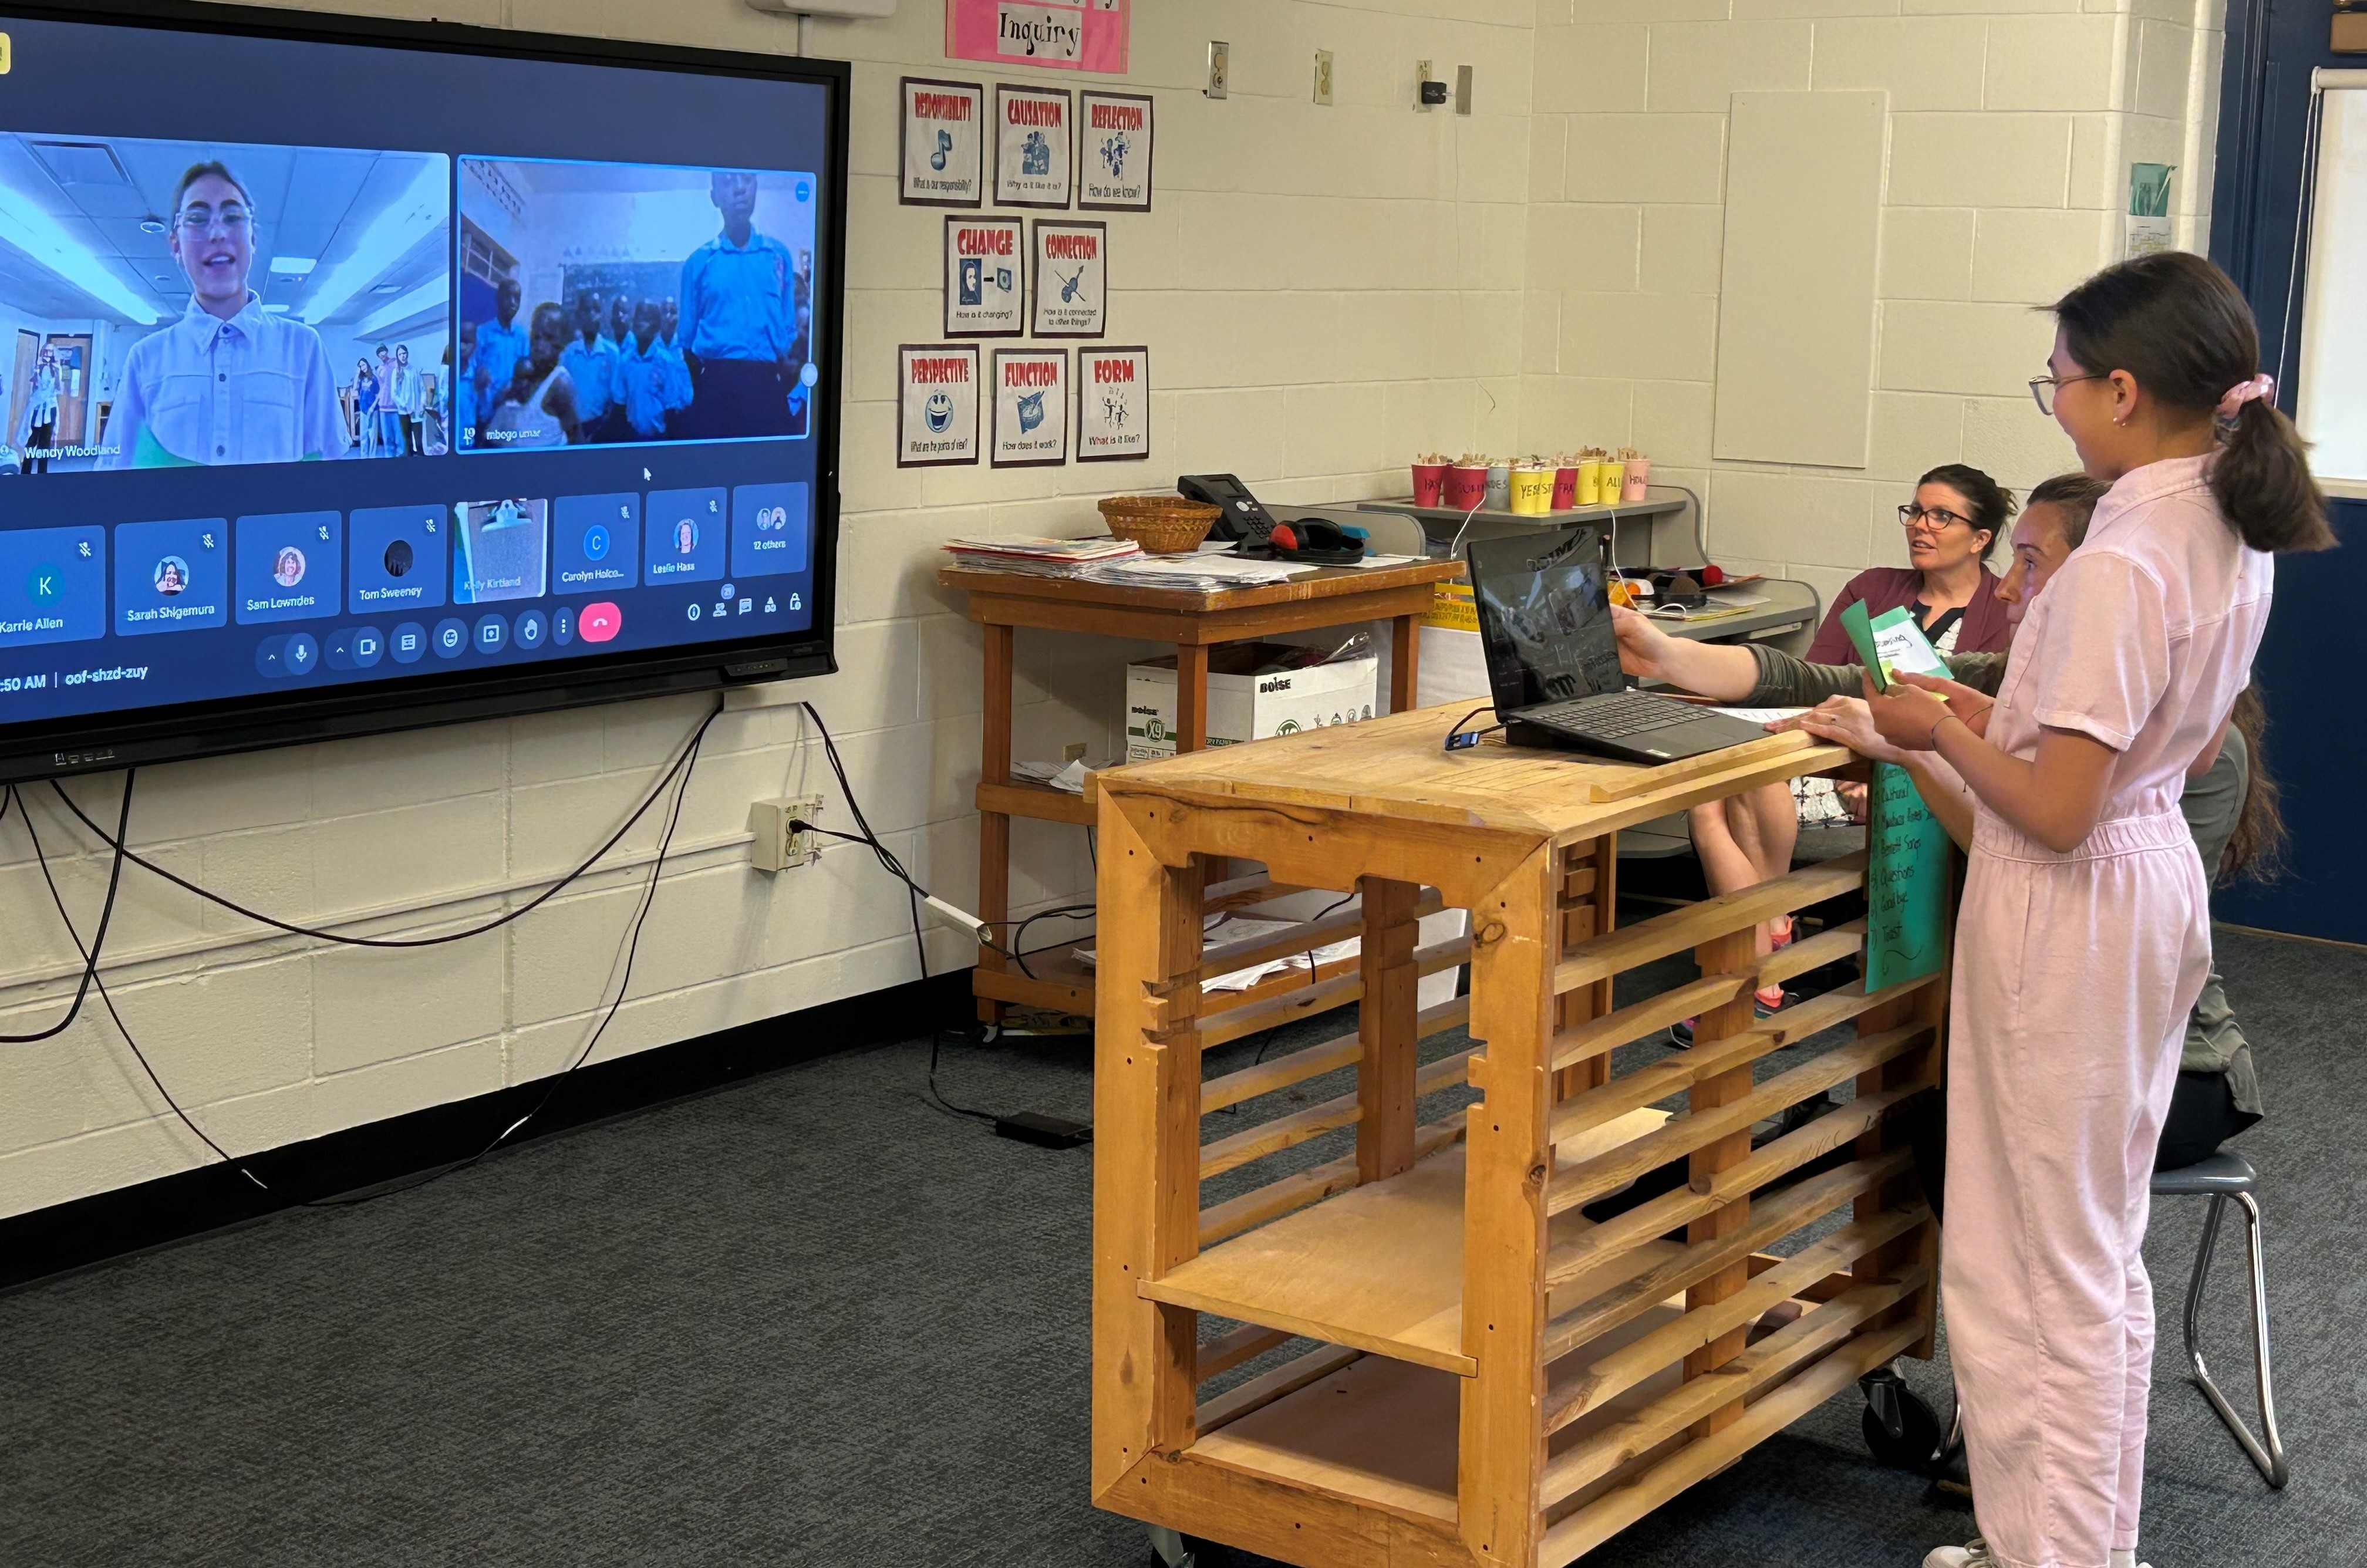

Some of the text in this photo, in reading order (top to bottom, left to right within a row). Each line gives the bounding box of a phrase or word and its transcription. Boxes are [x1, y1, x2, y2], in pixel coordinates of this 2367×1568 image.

[999, 12, 1081, 56] Inquiry
[1007, 99, 1061, 127] CAUSATION
[1091, 103, 1142, 131] REFLECTION
[957, 228, 1013, 255] CHANGE
[1046, 234, 1097, 261] CONNECTION
[911, 358, 969, 384] PERSPECTIVE
[1004, 361, 1057, 387] FUNCTION
[1094, 359, 1134, 383] FORM
[25, 444, 121, 460] Wendy Woodland
[39, 576, 52, 596] K
[561, 570, 594, 583] Carolyn
[247, 595, 315, 611] Sam Lowndes
[359, 586, 423, 601] Tom Sweeney
[127, 608, 158, 622] Sarah
[0, 617, 64, 634] Karrie Allen
[24, 674, 46, 690] AM
[1148, 721, 1162, 739] X9
